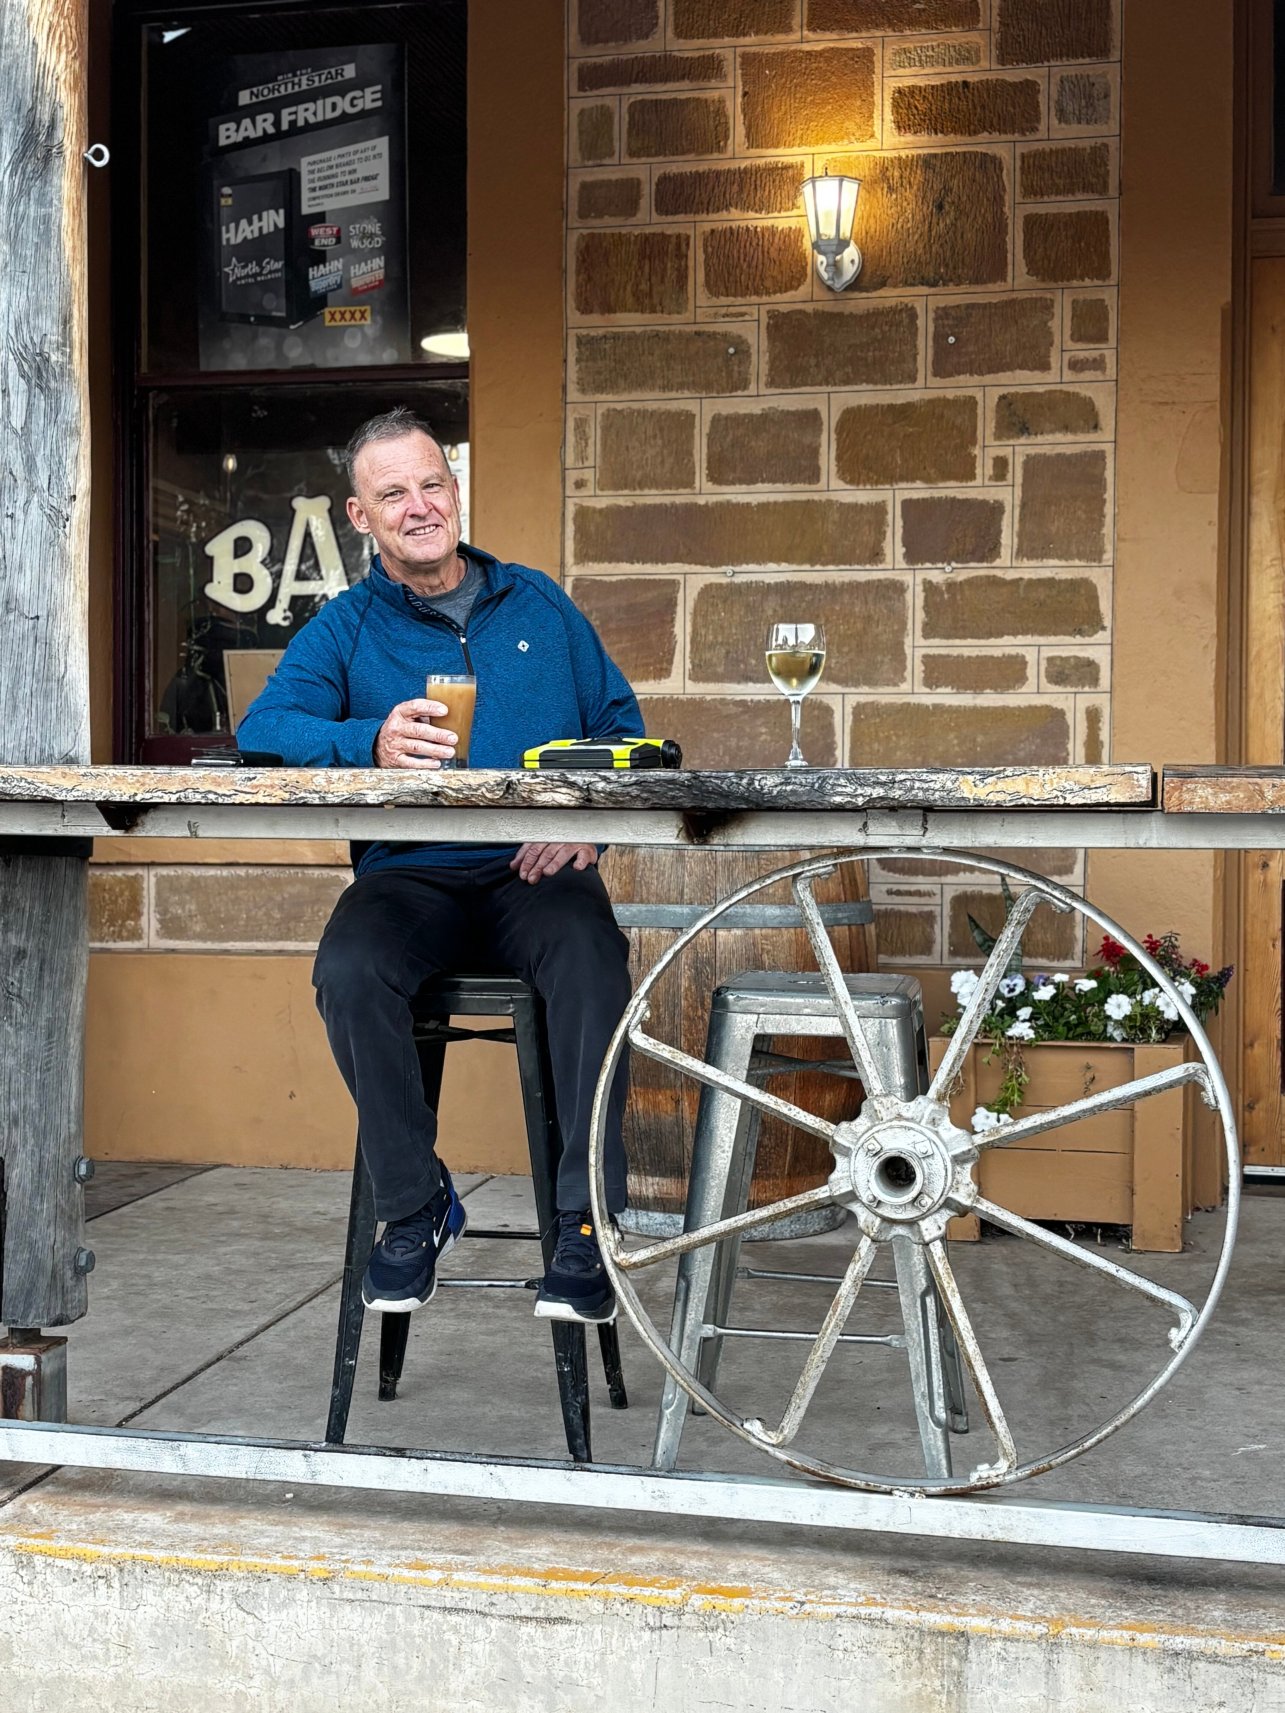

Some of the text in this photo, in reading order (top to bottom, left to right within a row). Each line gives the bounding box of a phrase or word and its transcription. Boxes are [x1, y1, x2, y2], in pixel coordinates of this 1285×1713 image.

[249, 67, 345, 101] NORTH STAR
[218, 84, 383, 147] BAR FRIDGE
[221, 208, 285, 246] HAHN
[310, 226, 339, 236] WEST
[349, 223, 382, 236] STONE
[314, 237, 336, 246] END
[349, 238, 382, 249] WOOD
[232, 257, 285, 280] North Star
[308, 257, 343, 280] HAHN
[350, 255, 385, 277] HAHN
[328, 308, 368, 323] XXXX
